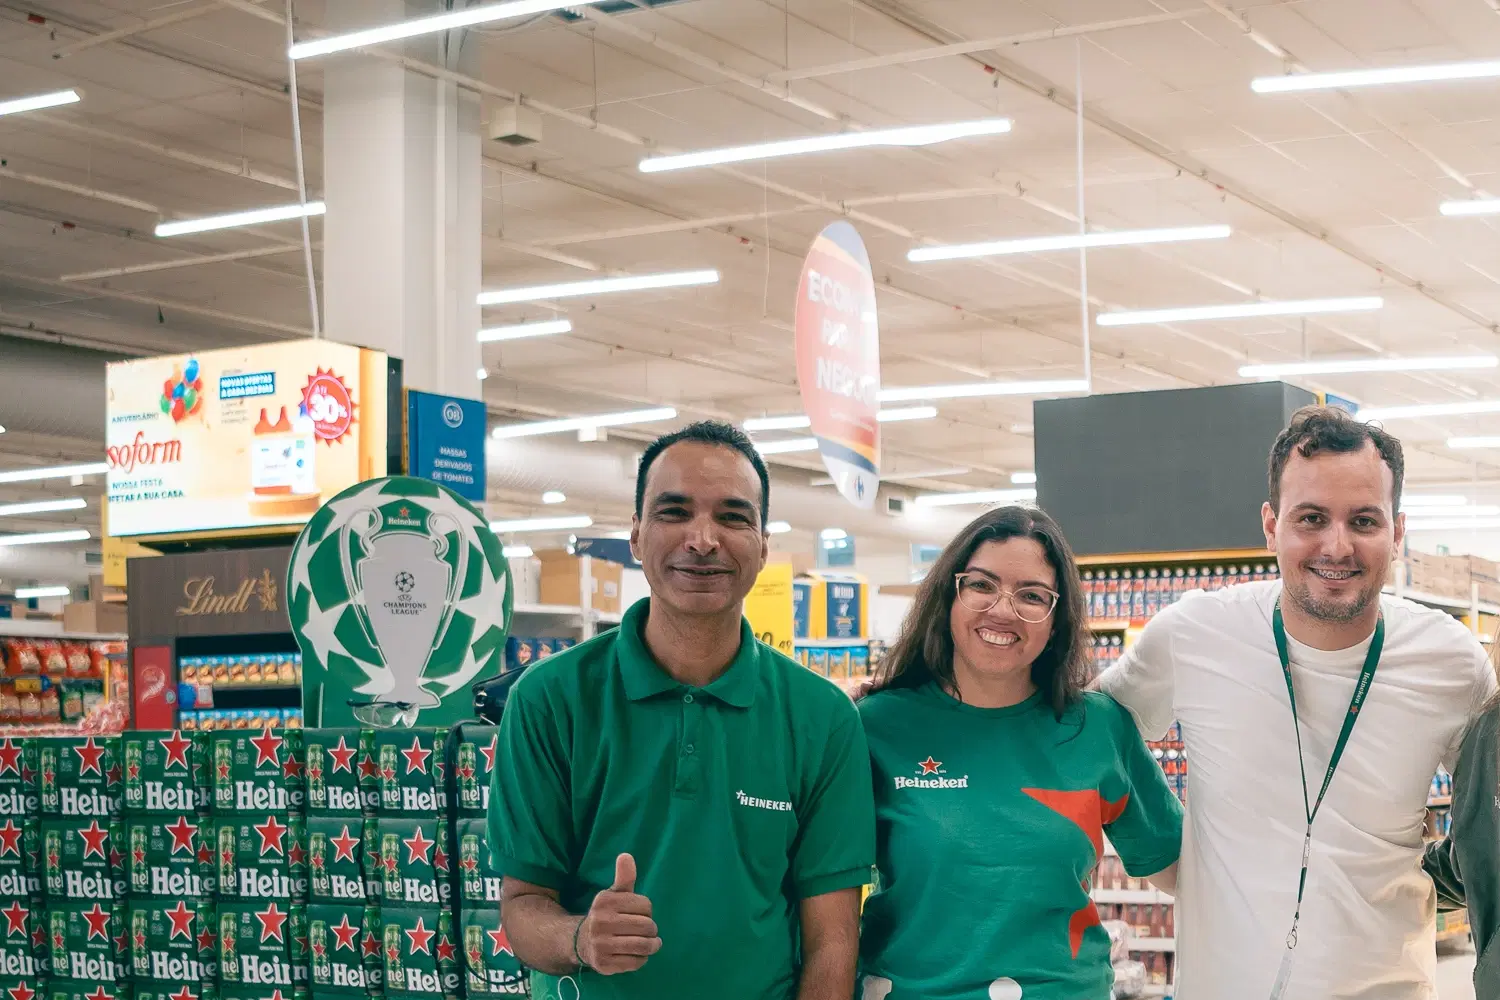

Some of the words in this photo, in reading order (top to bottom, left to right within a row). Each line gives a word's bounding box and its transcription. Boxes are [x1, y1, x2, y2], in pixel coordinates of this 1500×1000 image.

[434, 458, 473, 472] DERIVADOS
[176, 575, 258, 616] Lindt
[383, 601, 427, 609] CHAMPIONS
[1355, 672, 1371, 705] Heineken
[894, 775, 969, 790] Heineken
[740, 796, 793, 811] HEINEKEN
